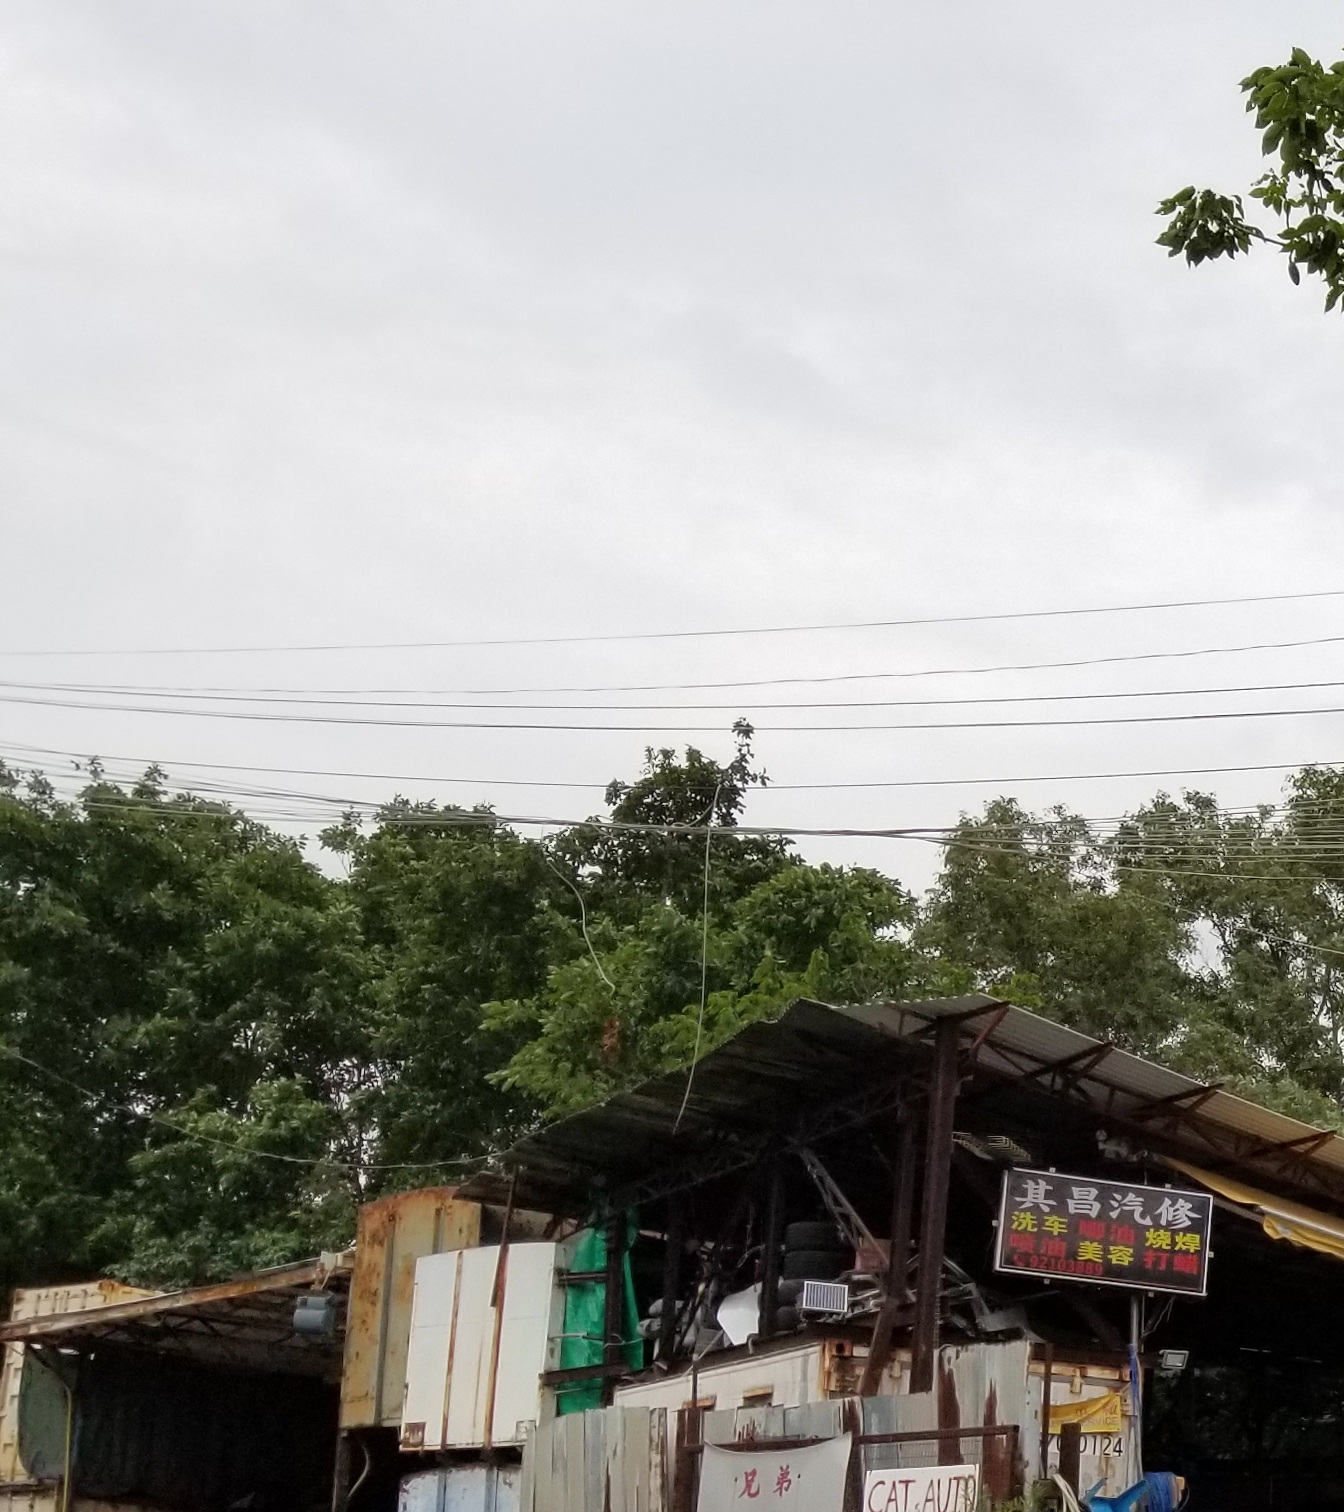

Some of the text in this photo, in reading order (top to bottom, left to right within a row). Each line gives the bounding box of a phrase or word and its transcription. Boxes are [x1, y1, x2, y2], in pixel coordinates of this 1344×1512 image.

[1014, 1178, 1202, 1229] 其昌汽修
[1011, 1211, 1068, 1235] 洗车
[1145, 1228, 1201, 1253] 烧焊
[1077, 1240, 1134, 1266] 美容
[738, 1465, 792, 1498] 兄弟
